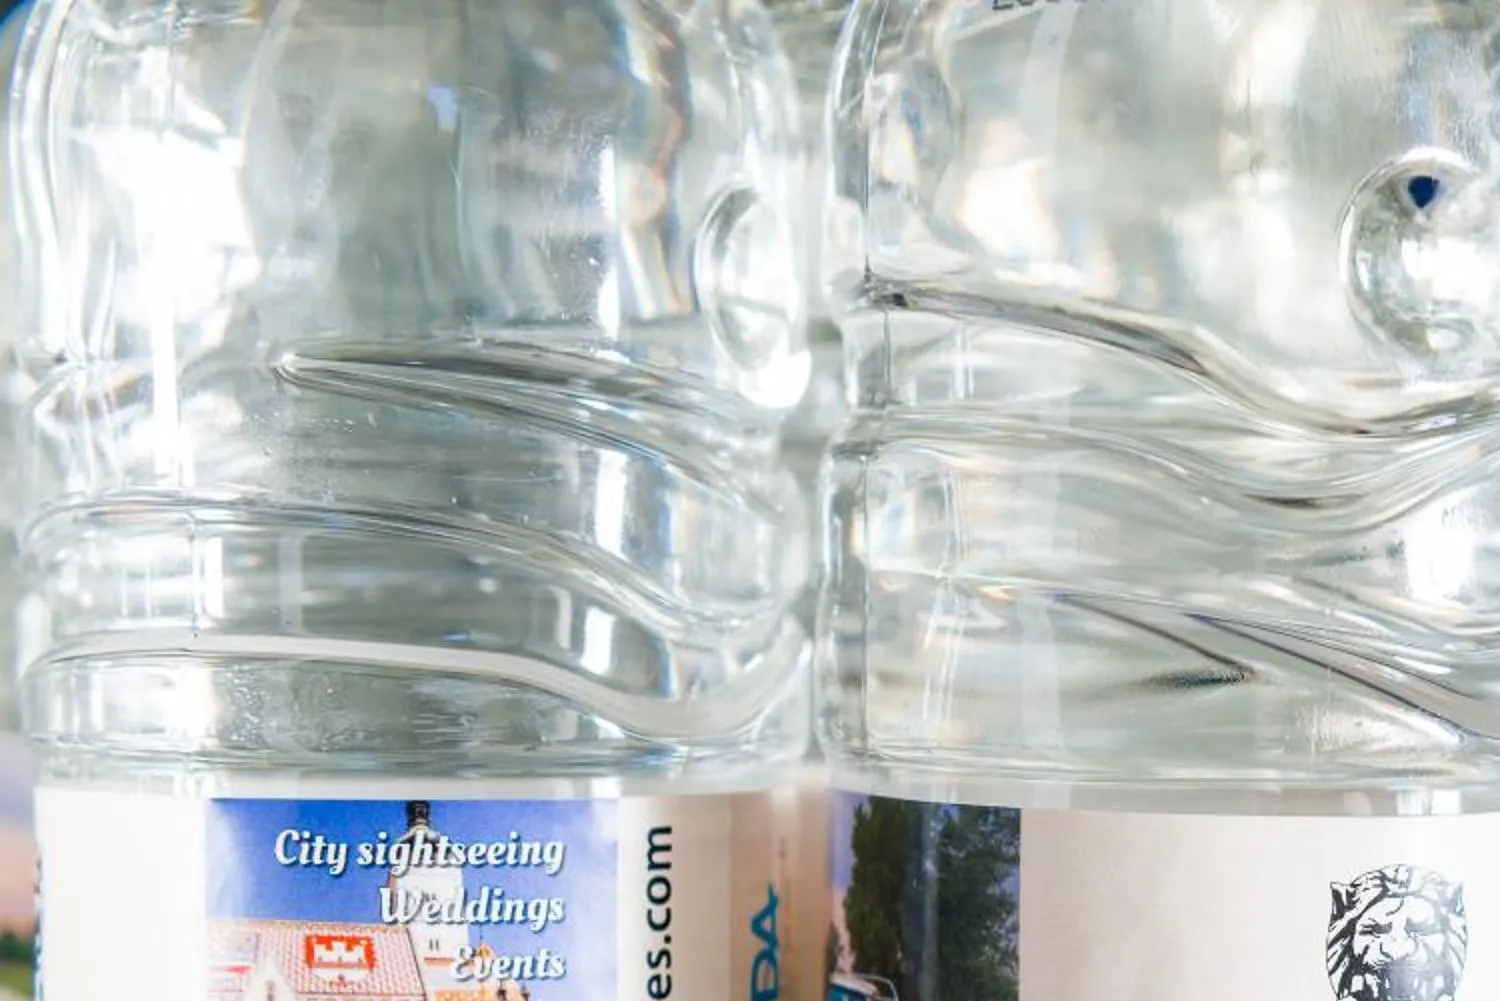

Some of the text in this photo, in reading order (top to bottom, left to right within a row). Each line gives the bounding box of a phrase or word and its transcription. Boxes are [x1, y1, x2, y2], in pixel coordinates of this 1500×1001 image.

[275, 829, 566, 878] City sightseeing
[379, 886, 566, 934] Weddings
[450, 945, 567, 983] Events
